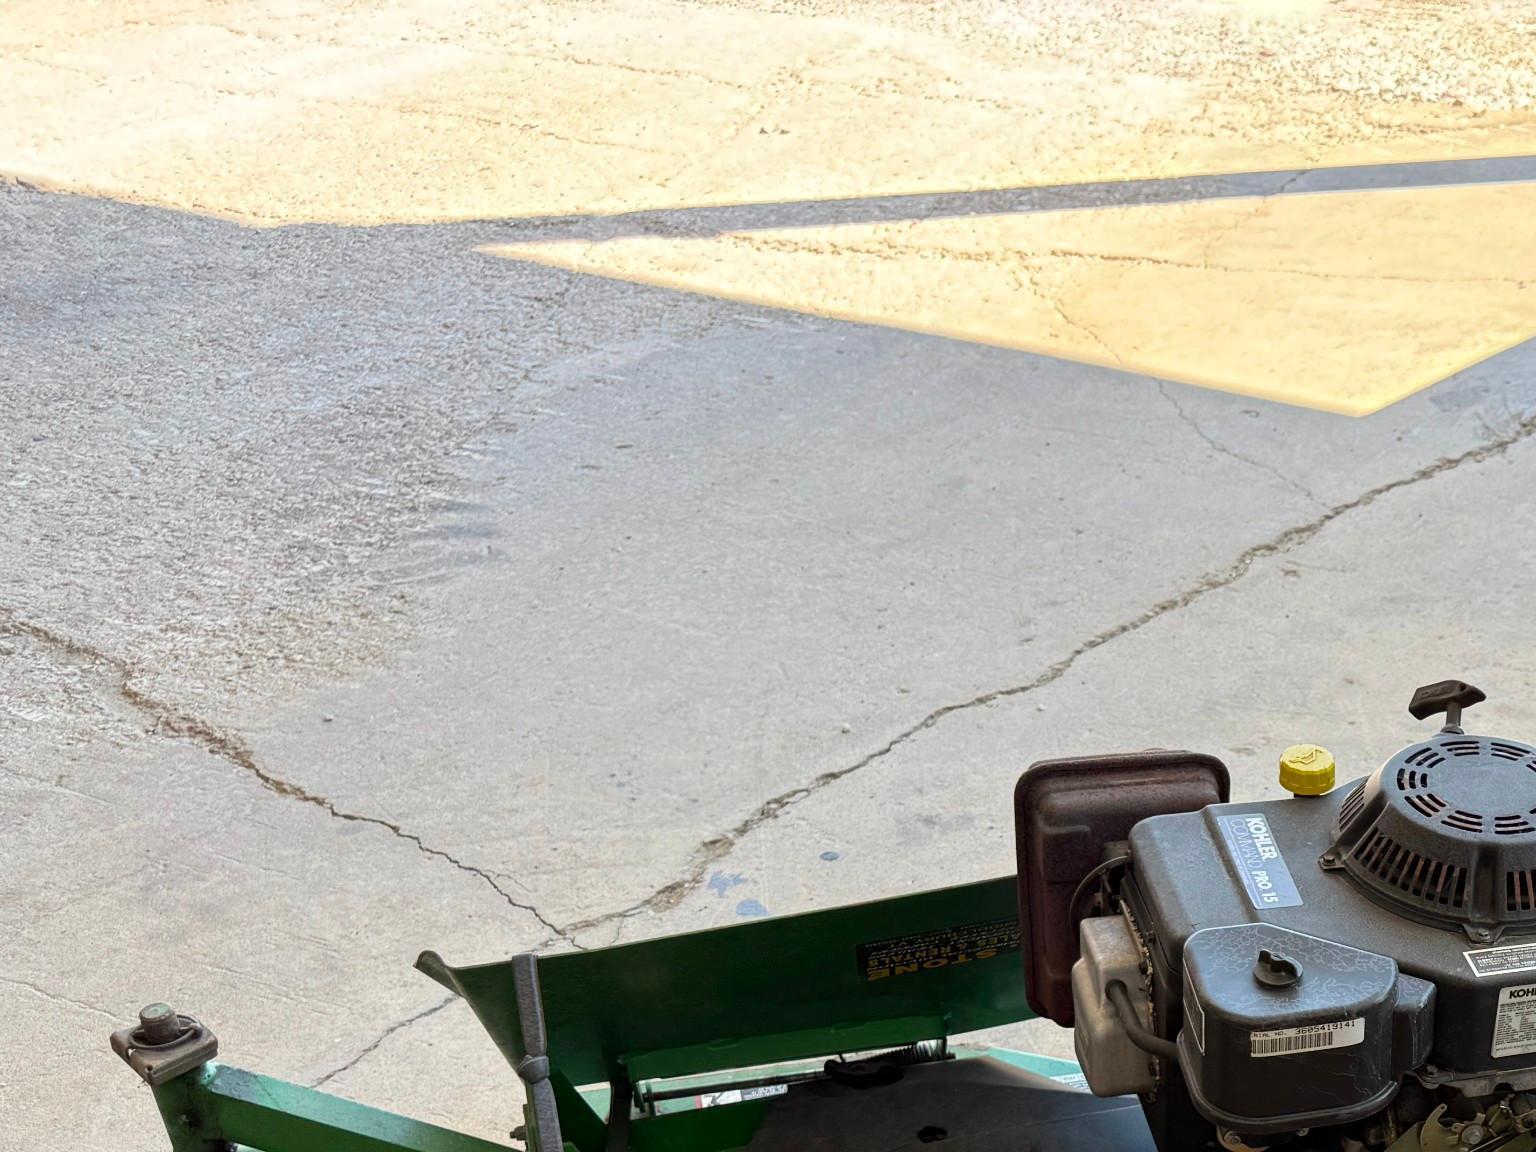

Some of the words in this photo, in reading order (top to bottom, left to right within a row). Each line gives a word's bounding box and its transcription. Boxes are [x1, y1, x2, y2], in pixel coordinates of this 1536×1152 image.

[1230, 819, 1263, 868] COMMAND
[1245, 817, 1278, 862] KOHLER
[868, 948, 998, 981] STONE
